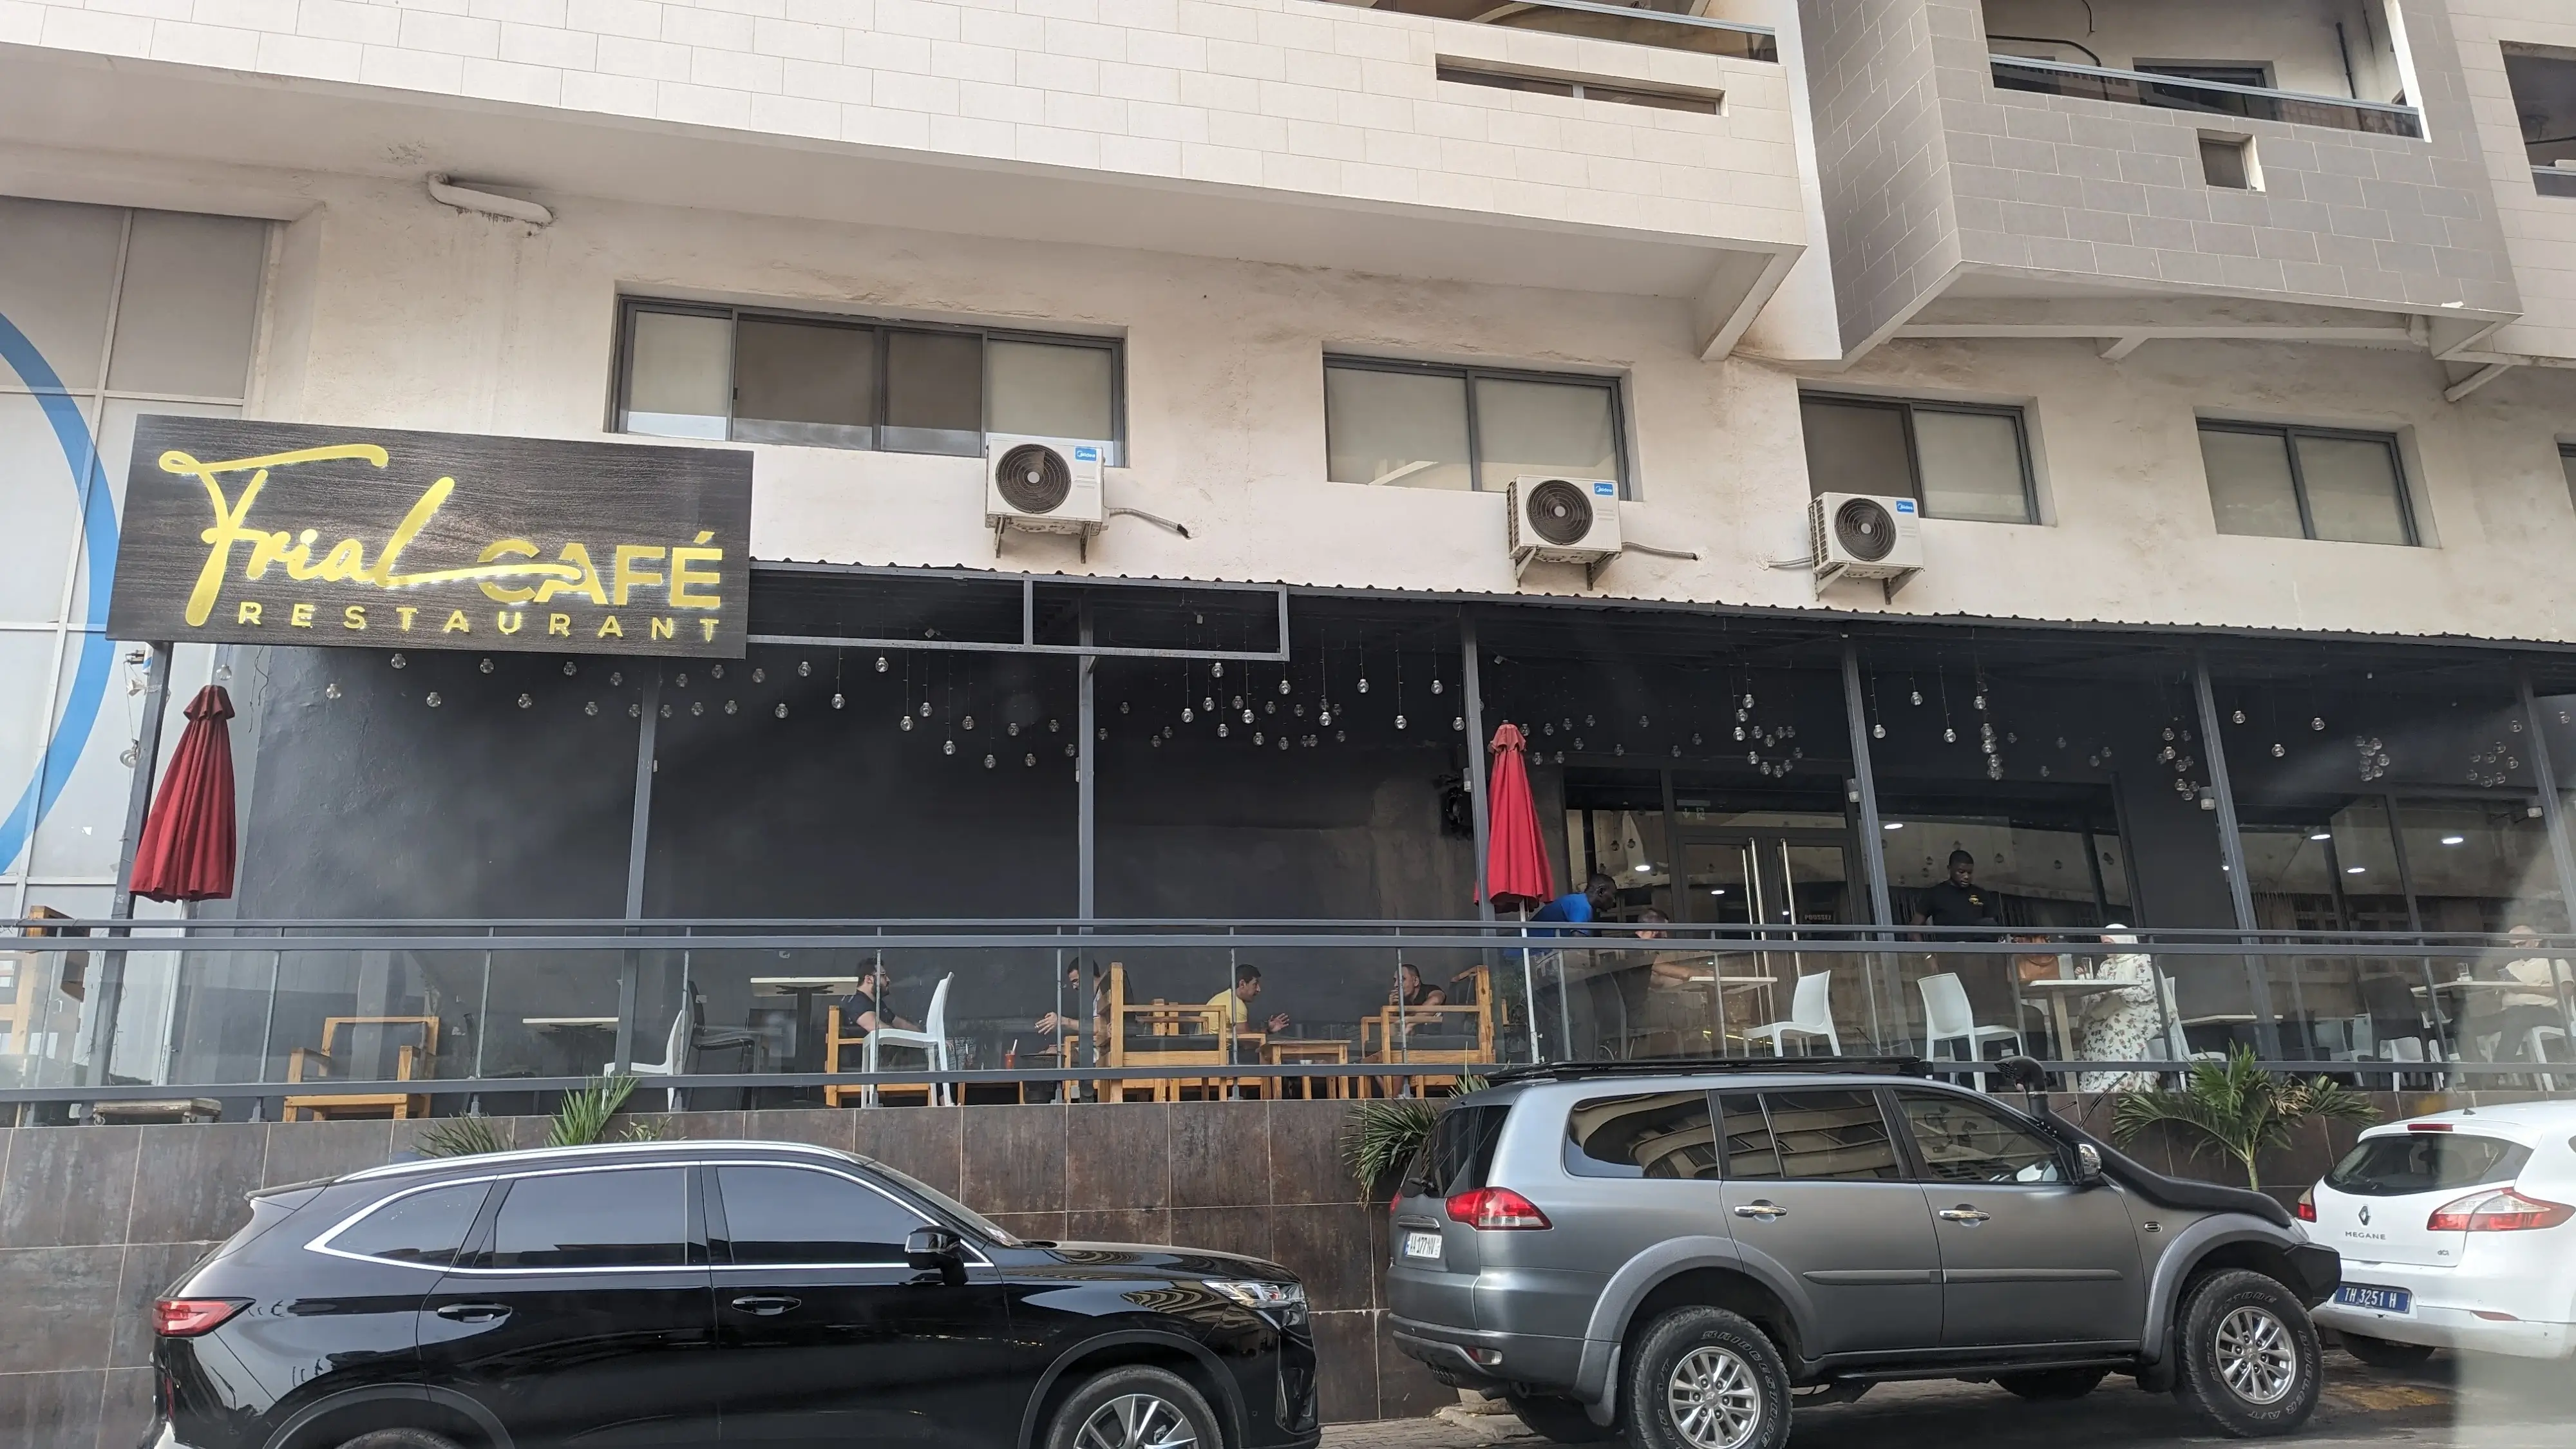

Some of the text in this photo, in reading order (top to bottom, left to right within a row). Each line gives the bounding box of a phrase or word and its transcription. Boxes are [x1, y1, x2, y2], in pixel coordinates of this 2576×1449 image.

[477, 531, 723, 608] CAFÉ
[237, 601, 720, 642] RESTAURANT
[2345, 1231, 2386, 1240] MEGANE
[2344, 1287, 2398, 1309] TH 3251 H
